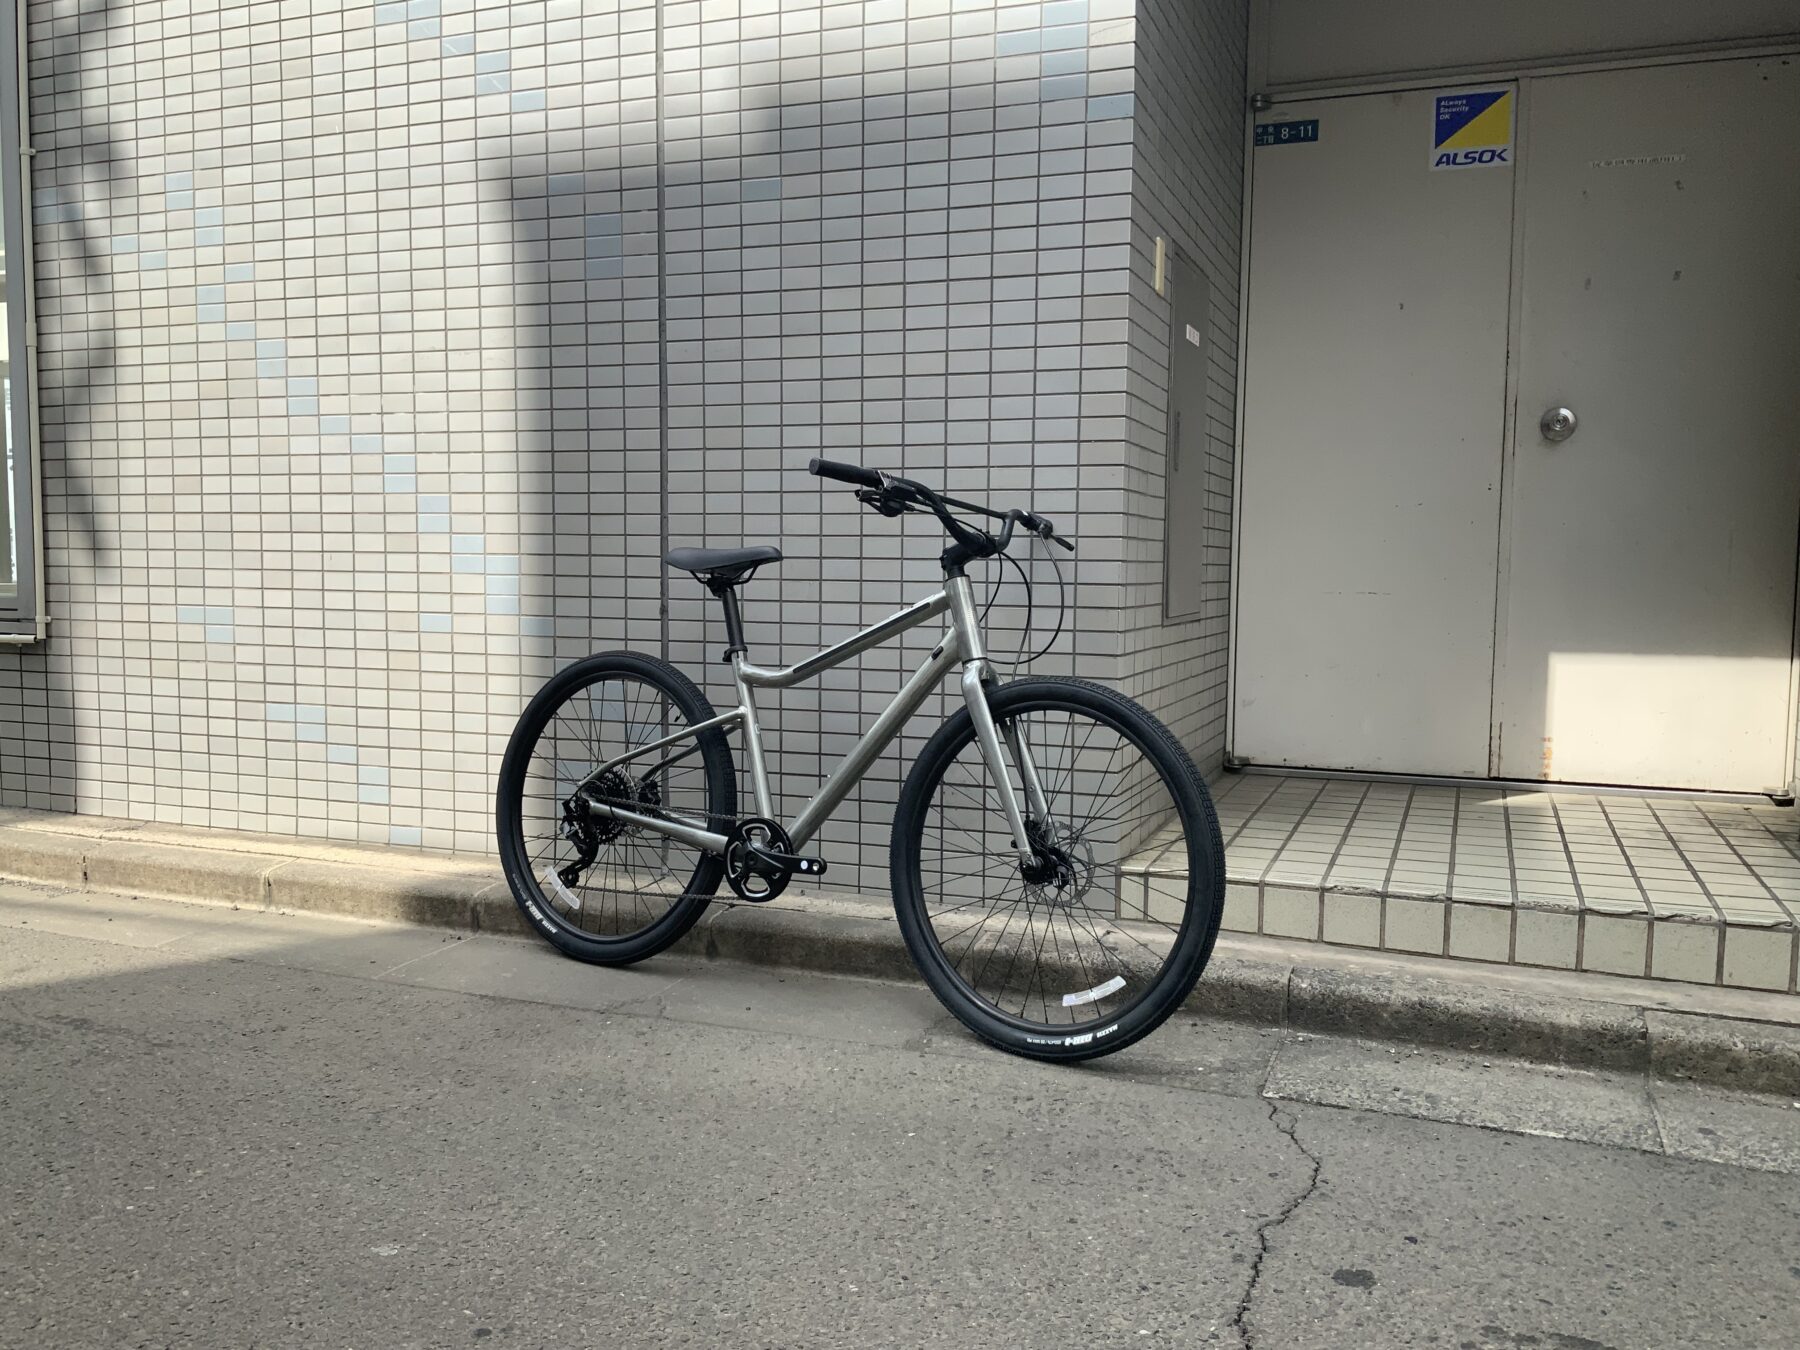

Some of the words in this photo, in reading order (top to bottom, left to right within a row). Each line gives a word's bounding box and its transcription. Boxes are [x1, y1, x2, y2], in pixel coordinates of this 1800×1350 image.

[1440, 105, 1470, 113] Security
[1281, 125, 1312, 140] 8-11
[1434, 148, 1509, 167] ALSOK
